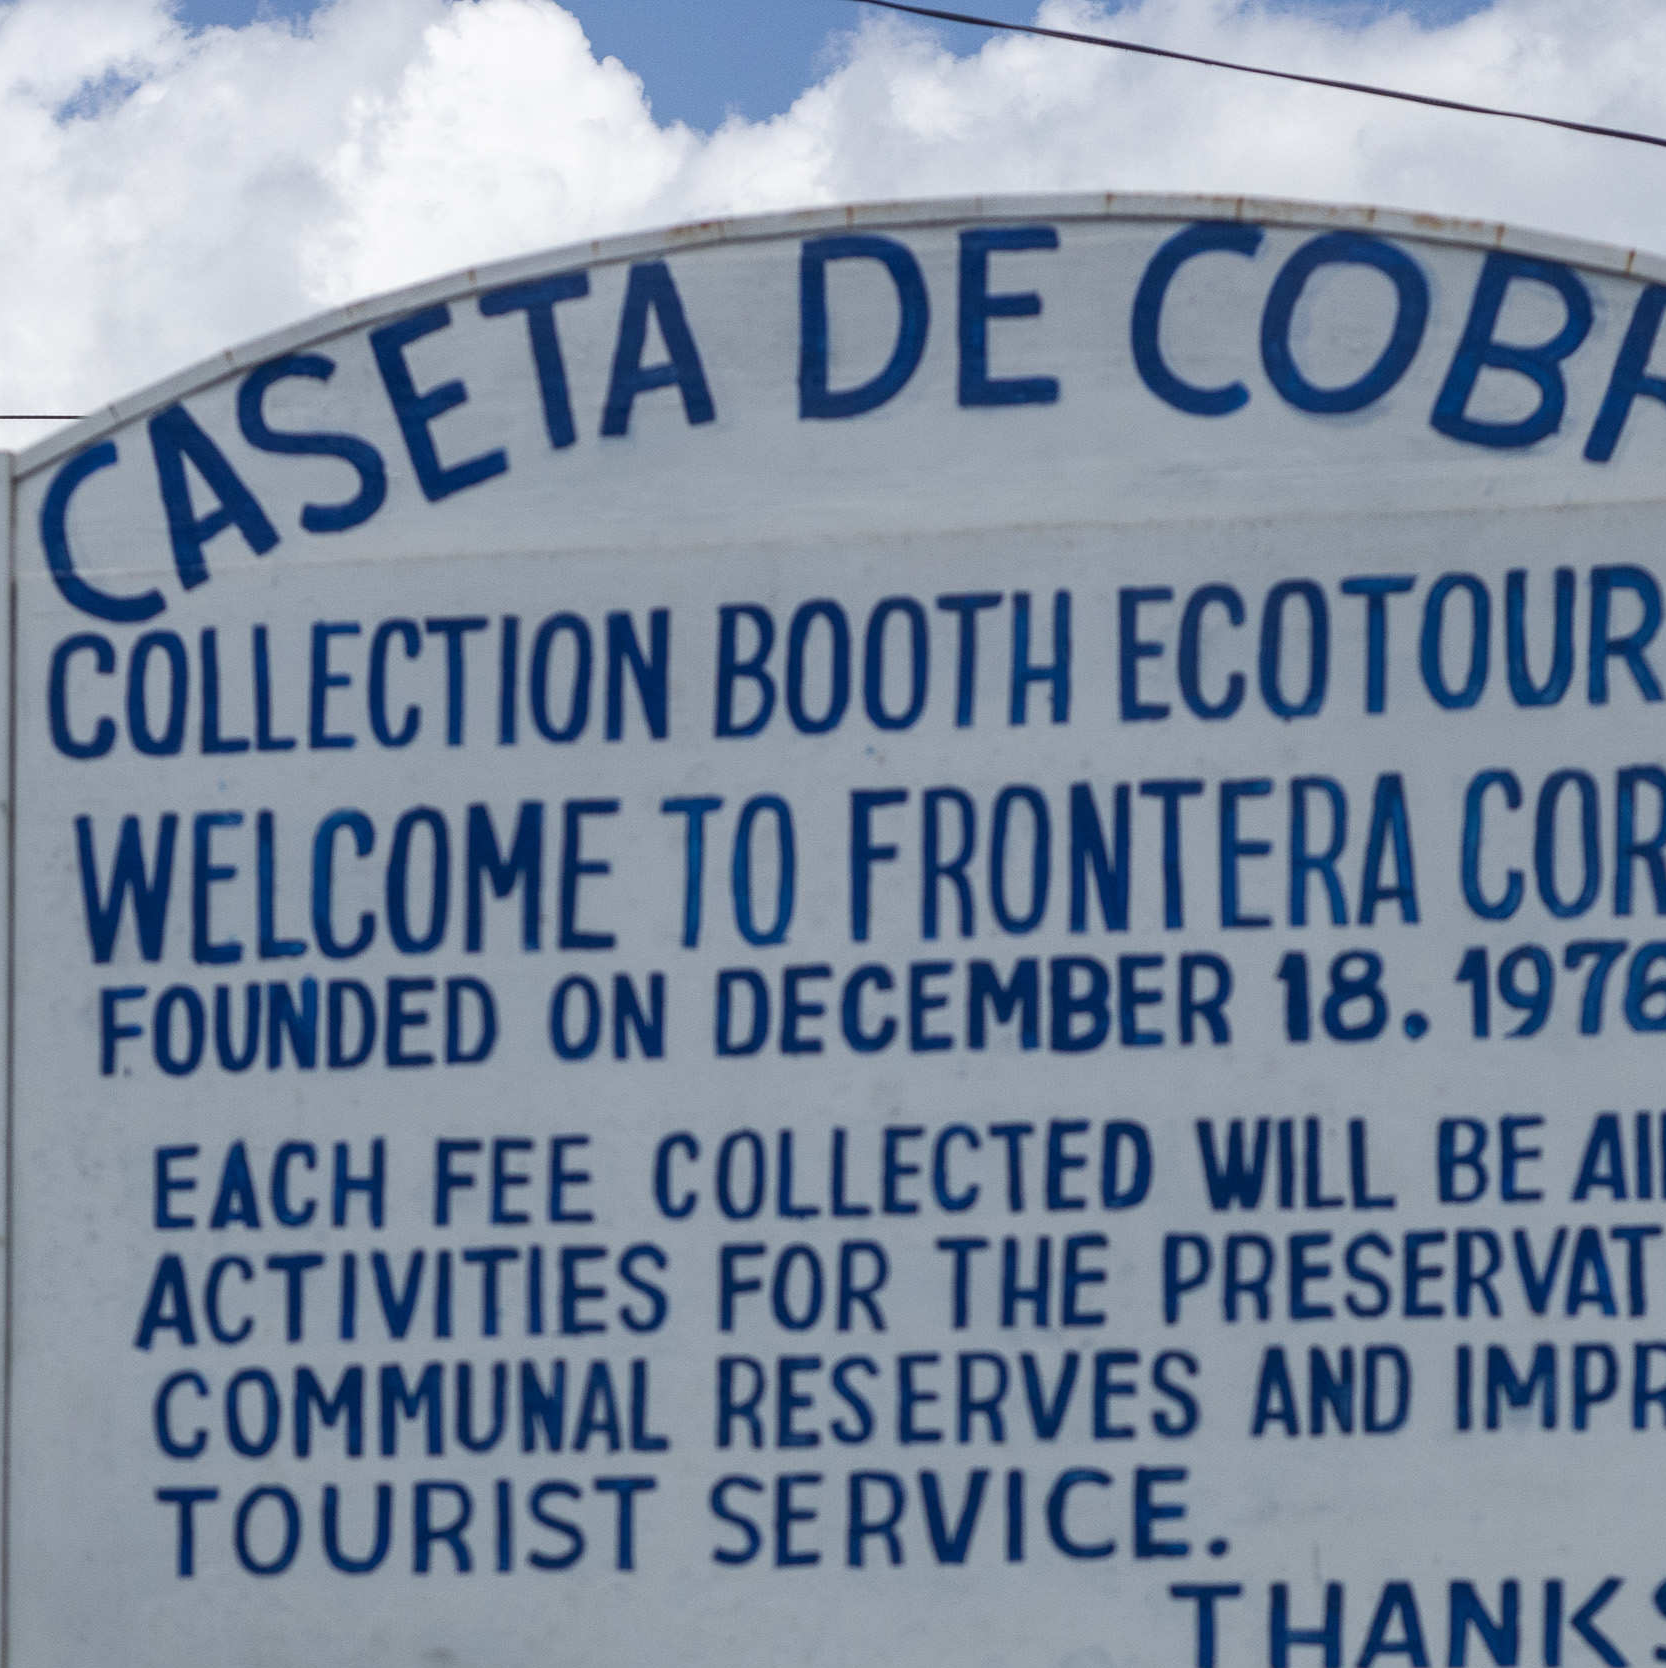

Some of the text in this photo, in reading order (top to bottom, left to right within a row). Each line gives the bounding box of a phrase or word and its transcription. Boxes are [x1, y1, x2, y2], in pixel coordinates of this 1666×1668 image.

[36, 258, 719, 627] CASETA
[794, 222, 1063, 423] DE
[46, 607, 672, 763] COLLECTION
[712, 587, 1074, 742] BOOTH
[72, 795, 623, 969] WELCOME
[658, 790, 798, 952] TO
[846, 770, 1423, 946] FRONTERA
[98, 973, 500, 1079] FOUNDED
[546, 972, 668, 1064] ON
[712, 949, 1235, 1059] DECEMBER
[1276, 947, 1432, 1046] 18.
[152, 1135, 388, 1233] EACH
[432, 1133, 594, 1229] FEE
[652, 1117, 1156, 1223] COLLECTED
[1196, 1117, 1397, 1213] WILL
[1434, 1112, 1544, 1207] BE
[134, 1241, 672, 1354] ACTIVITIES
[718, 1238, 891, 1335] FOR
[936, 1229, 1108, 1331] THE
[152, 1358, 670, 1462] COMMUNAL
[715, 1348, 1202, 1451] RESERVES
[1250, 1343, 1413, 1438] AND
[155, 1465, 1233, 1580] TOURIST SERVICE.
